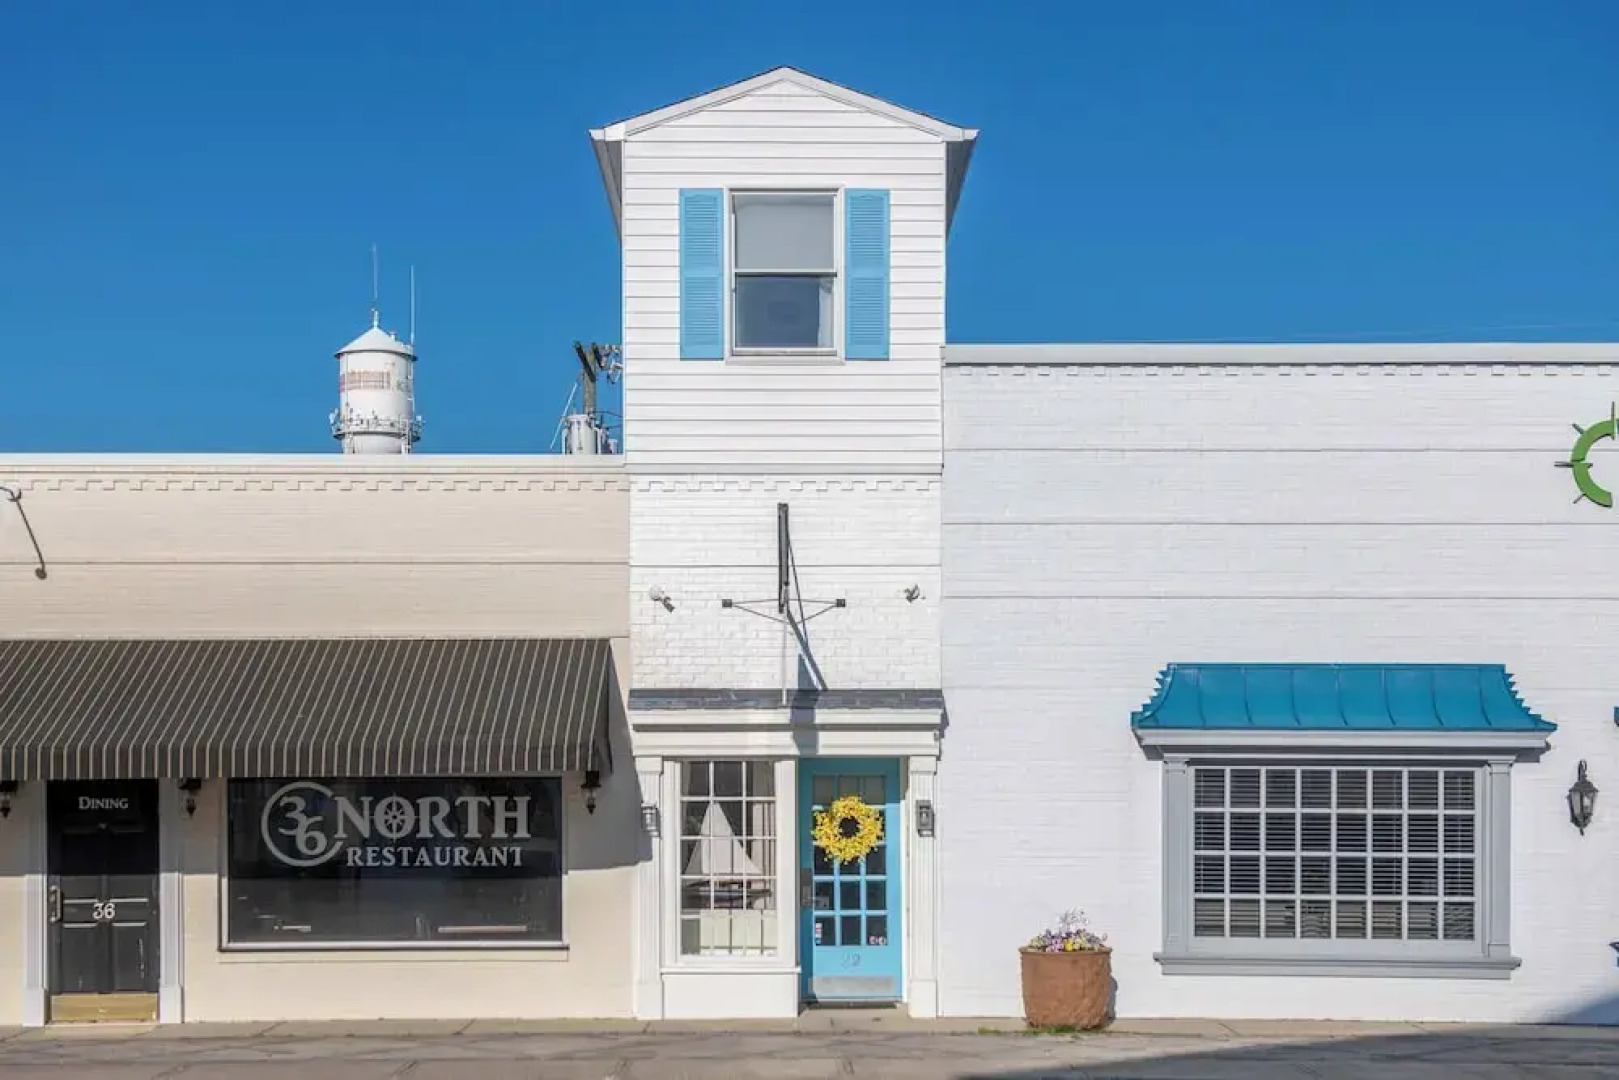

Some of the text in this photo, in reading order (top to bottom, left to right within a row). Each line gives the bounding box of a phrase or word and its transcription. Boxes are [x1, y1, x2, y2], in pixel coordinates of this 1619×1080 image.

[278, 795, 532, 856] 36 NORTH
[347, 847, 522, 867] RESTAURANT
[92, 902, 116, 919] 36
